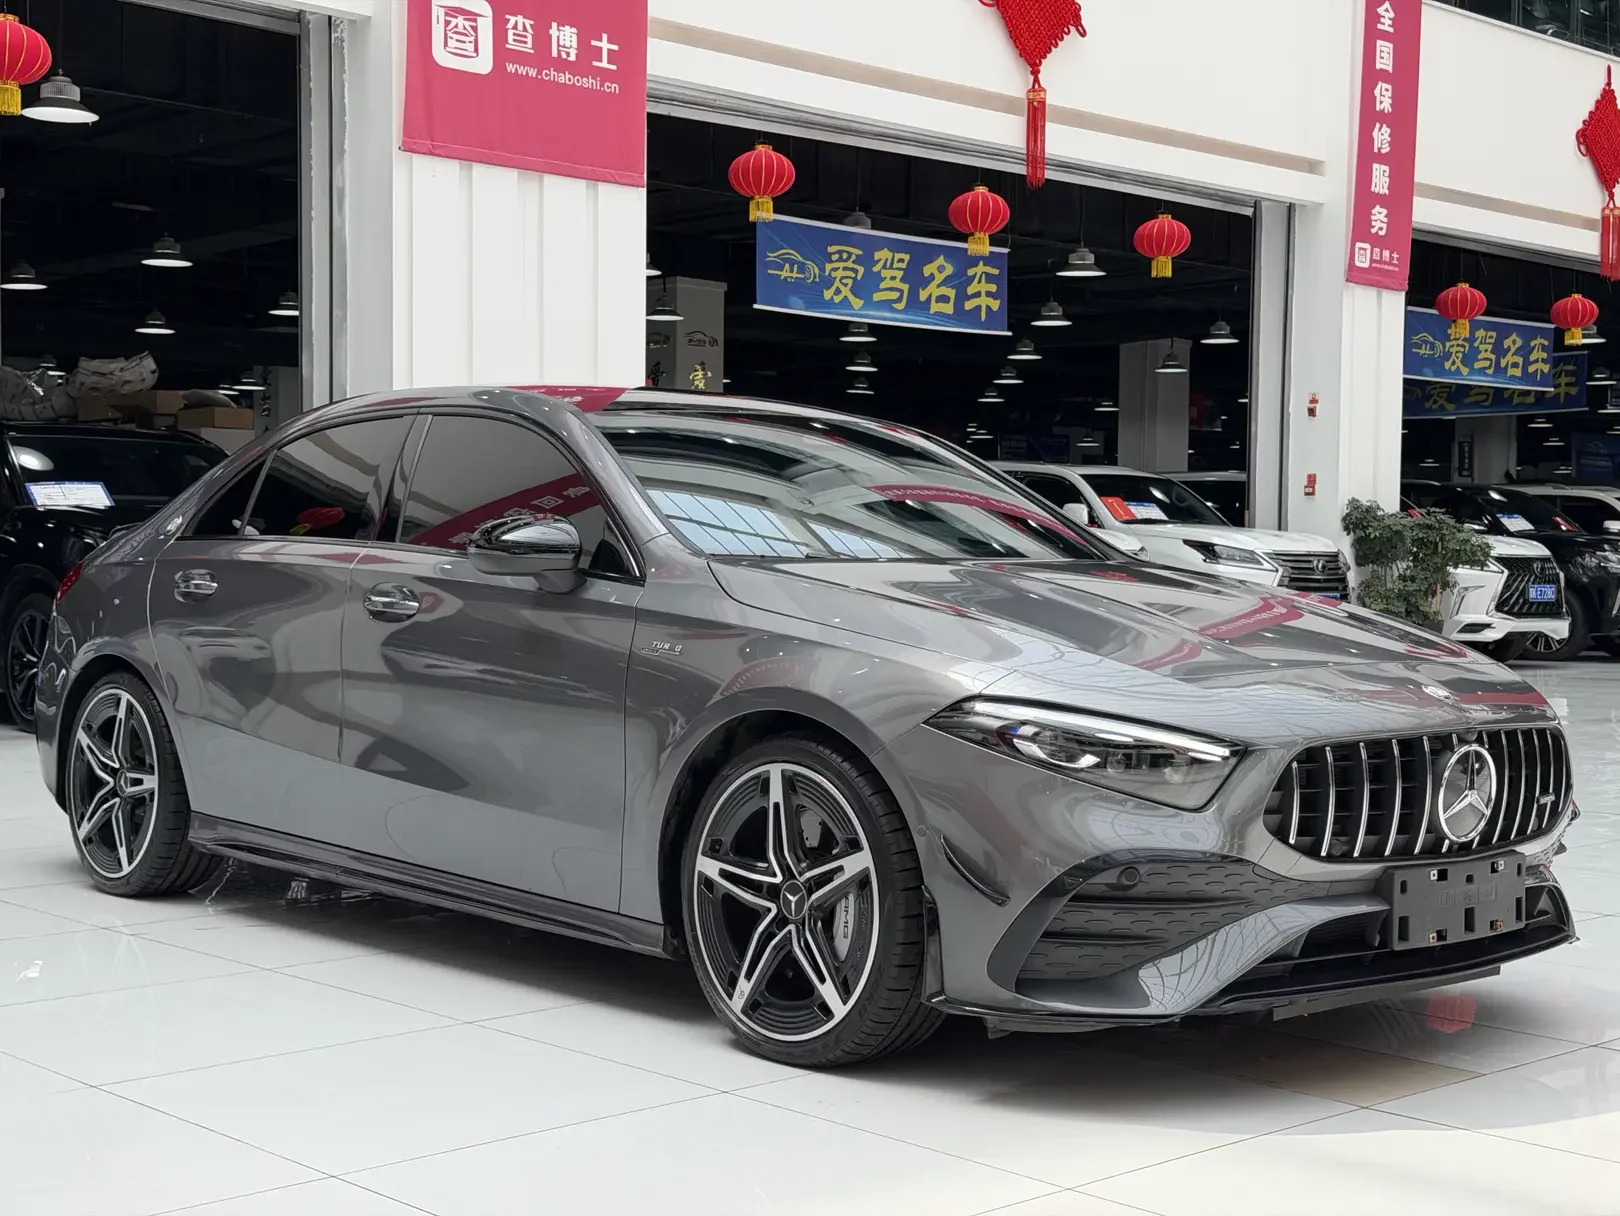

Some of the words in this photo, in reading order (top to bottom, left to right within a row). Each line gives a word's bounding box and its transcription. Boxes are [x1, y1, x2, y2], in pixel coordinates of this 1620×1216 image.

[505, 14, 619, 71] 查博士
[505, 62, 620, 94] www.chaboshi.cn
[1370, 0, 1396, 236] 全国保修服务
[823, 245, 1001, 321] 爱驾名车
[1444, 327, 1551, 381] 爱驾名车
